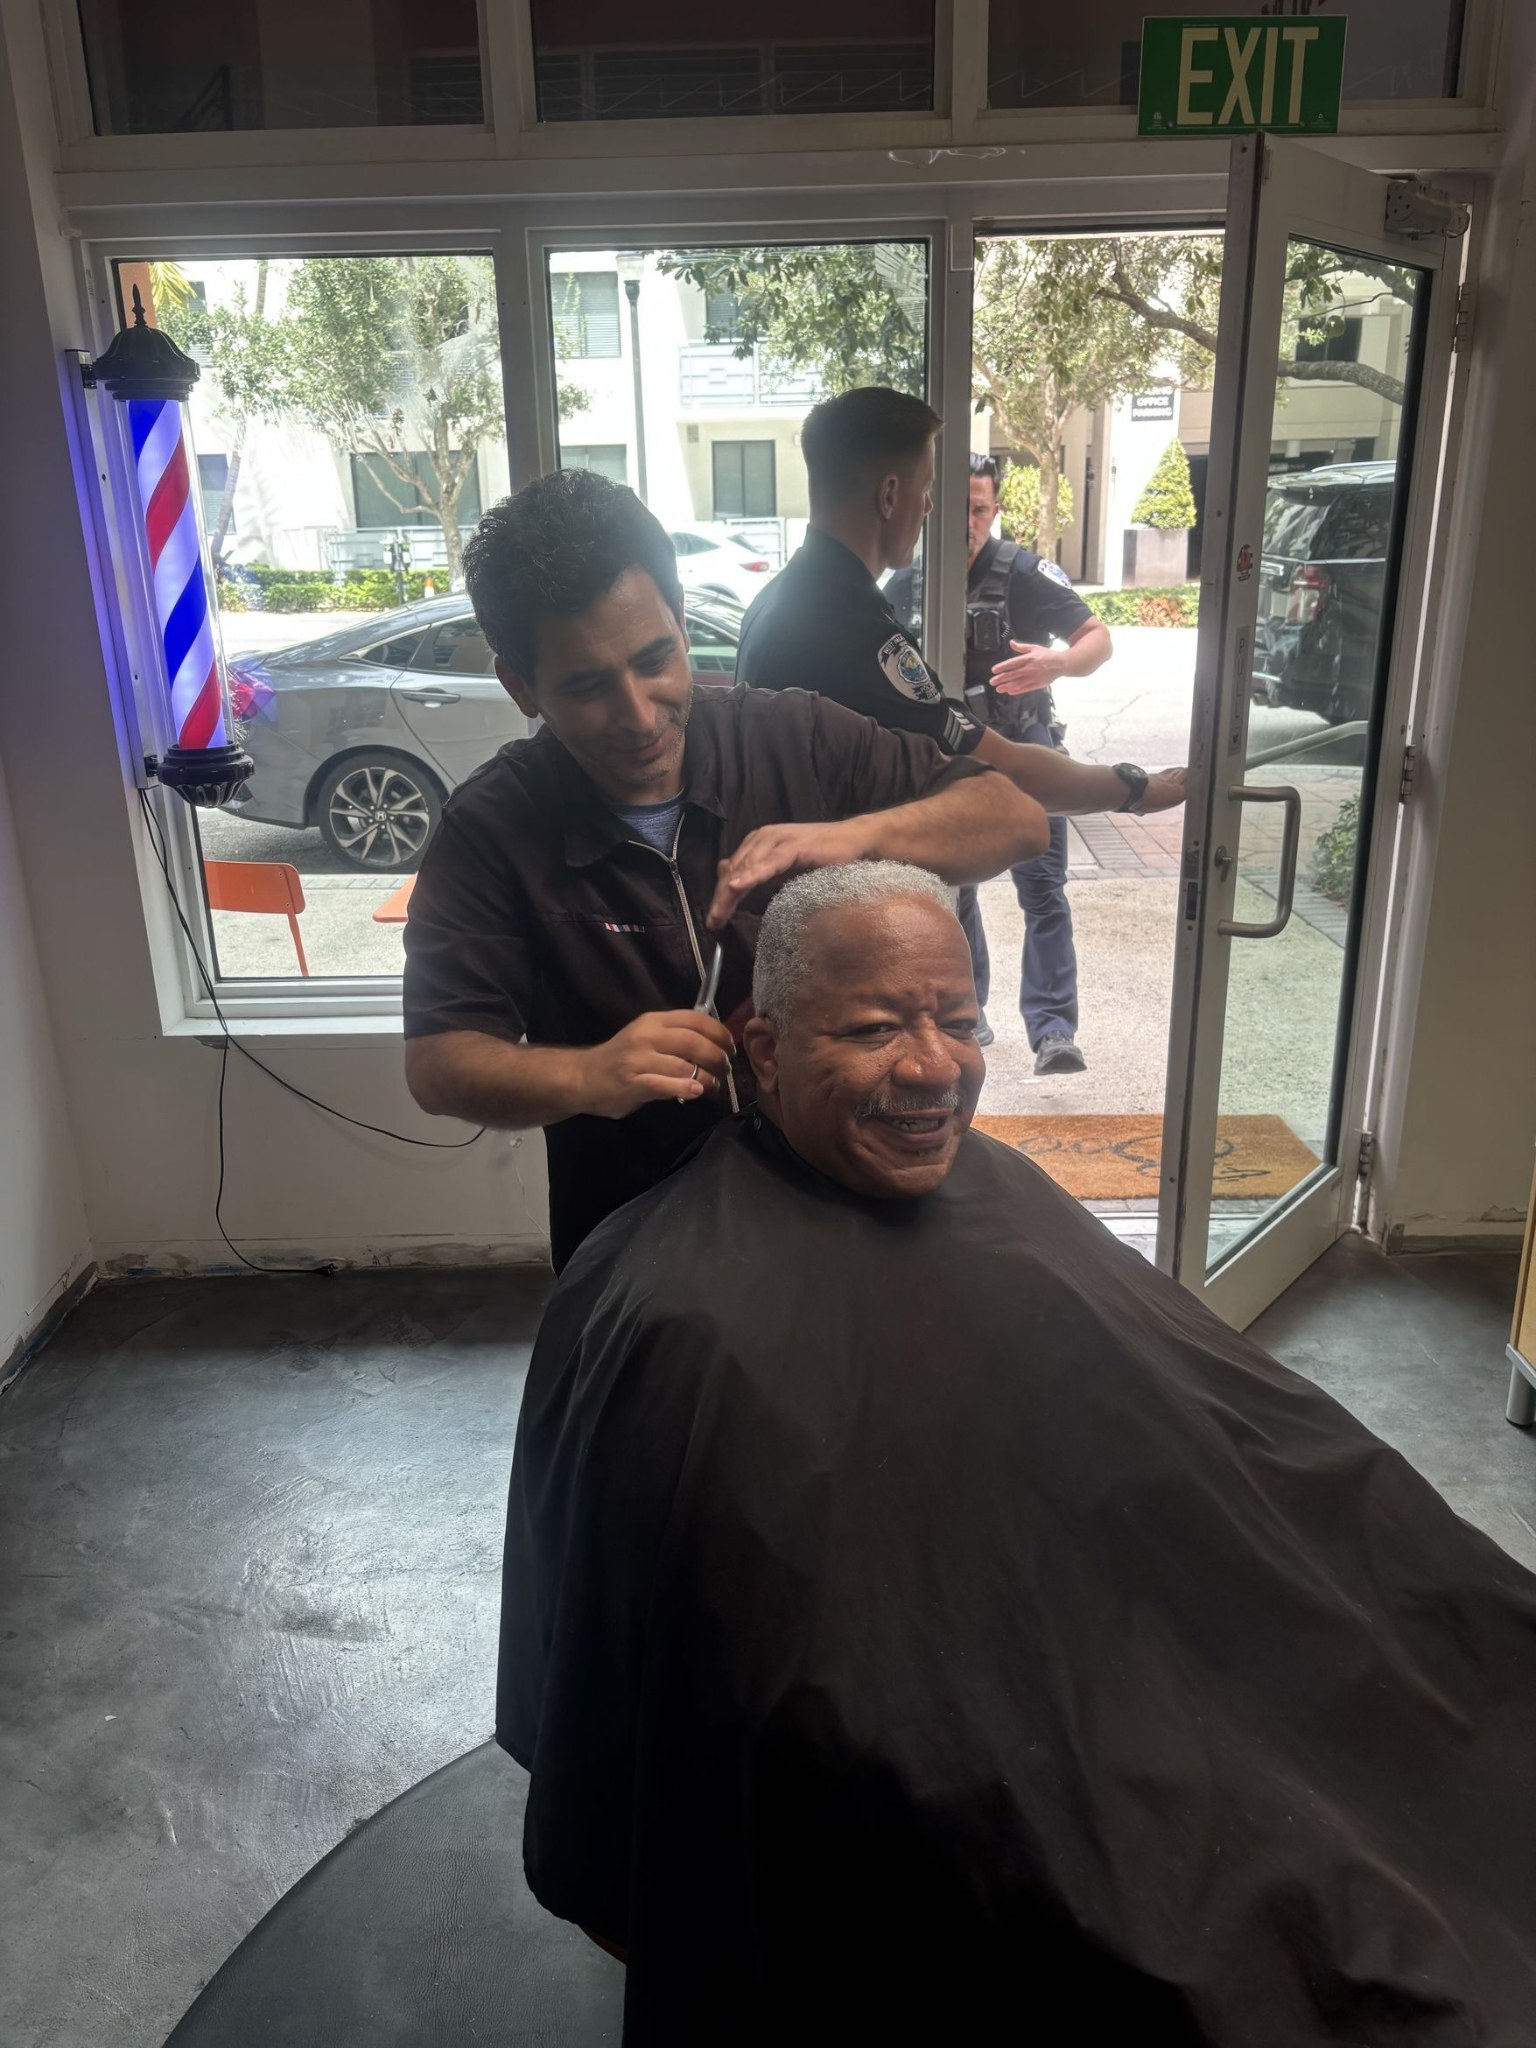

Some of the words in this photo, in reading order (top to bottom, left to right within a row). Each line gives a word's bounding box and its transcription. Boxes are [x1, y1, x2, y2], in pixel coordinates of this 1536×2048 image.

[1177, 26, 1320, 125] EXIT
[1136, 396, 1169, 406] OFFICE
[1234, 637, 1246, 719] PULL
